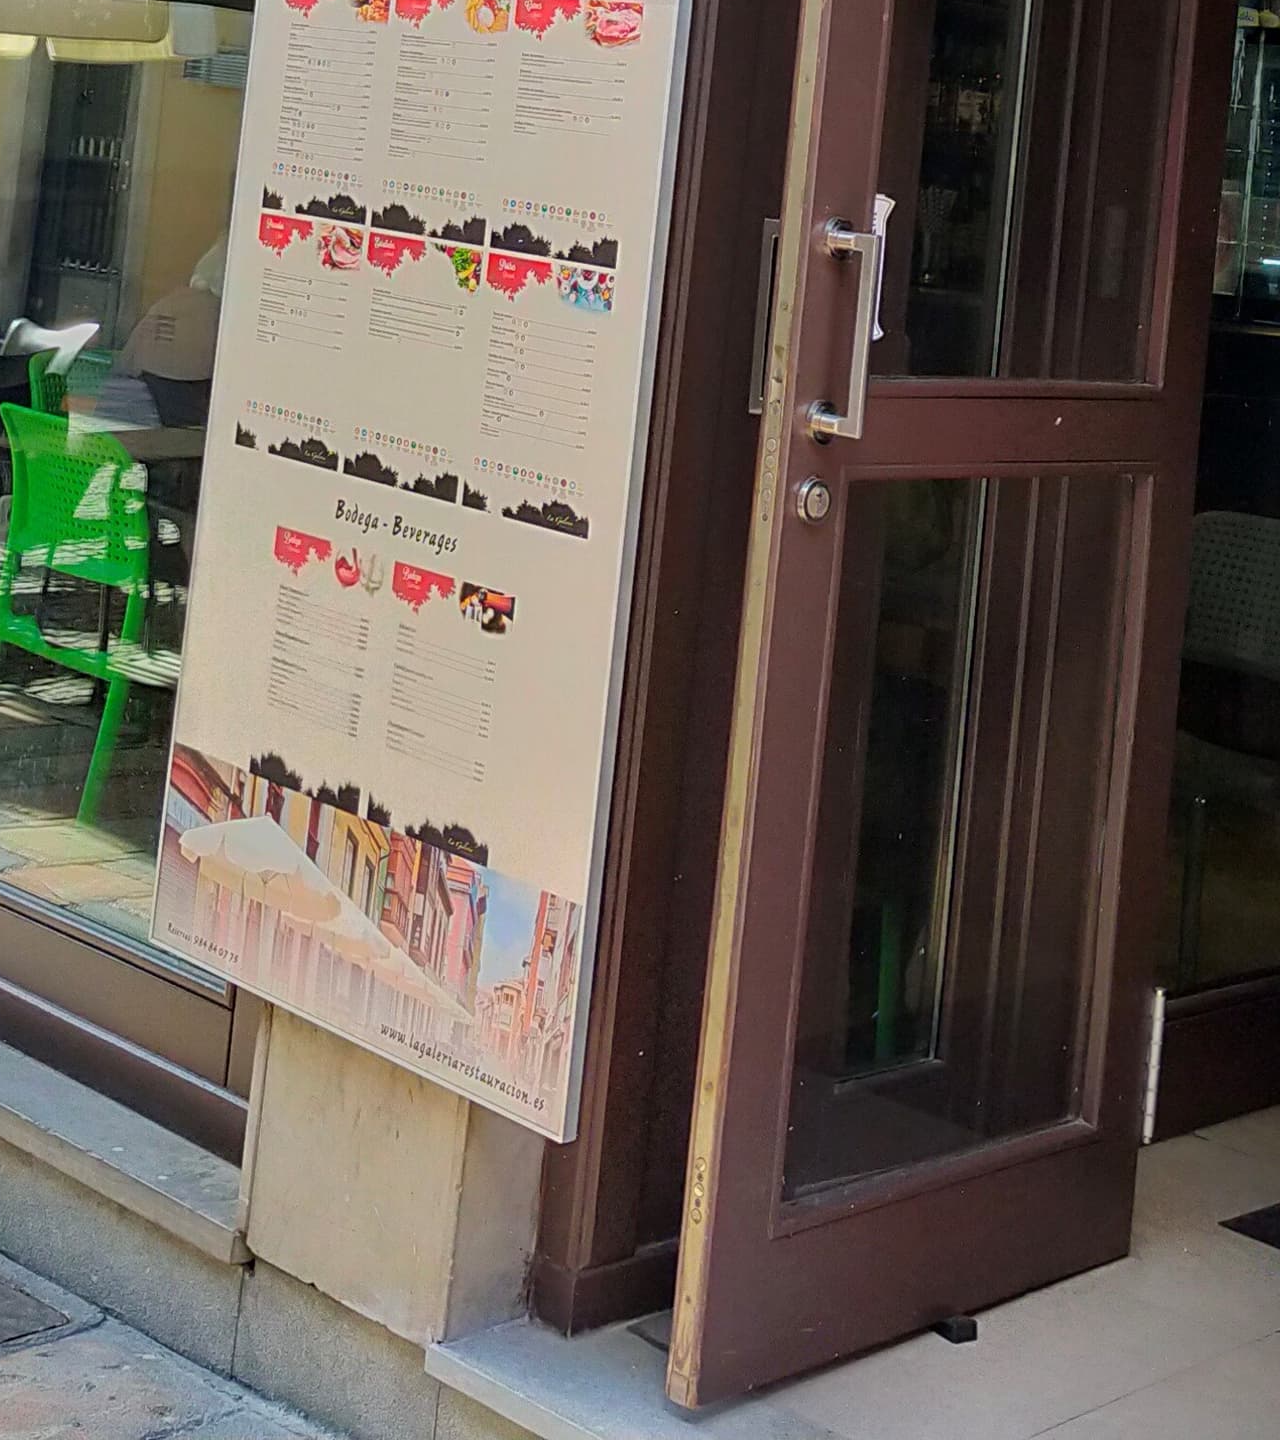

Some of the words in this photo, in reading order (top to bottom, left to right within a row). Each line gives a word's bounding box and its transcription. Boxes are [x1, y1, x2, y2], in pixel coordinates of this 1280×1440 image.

[335, 499, 380, 534] Bodega
[391, 514, 459, 556] Beverages
[380, 1023, 546, 1111] www.lagaleriarestauracion.es
